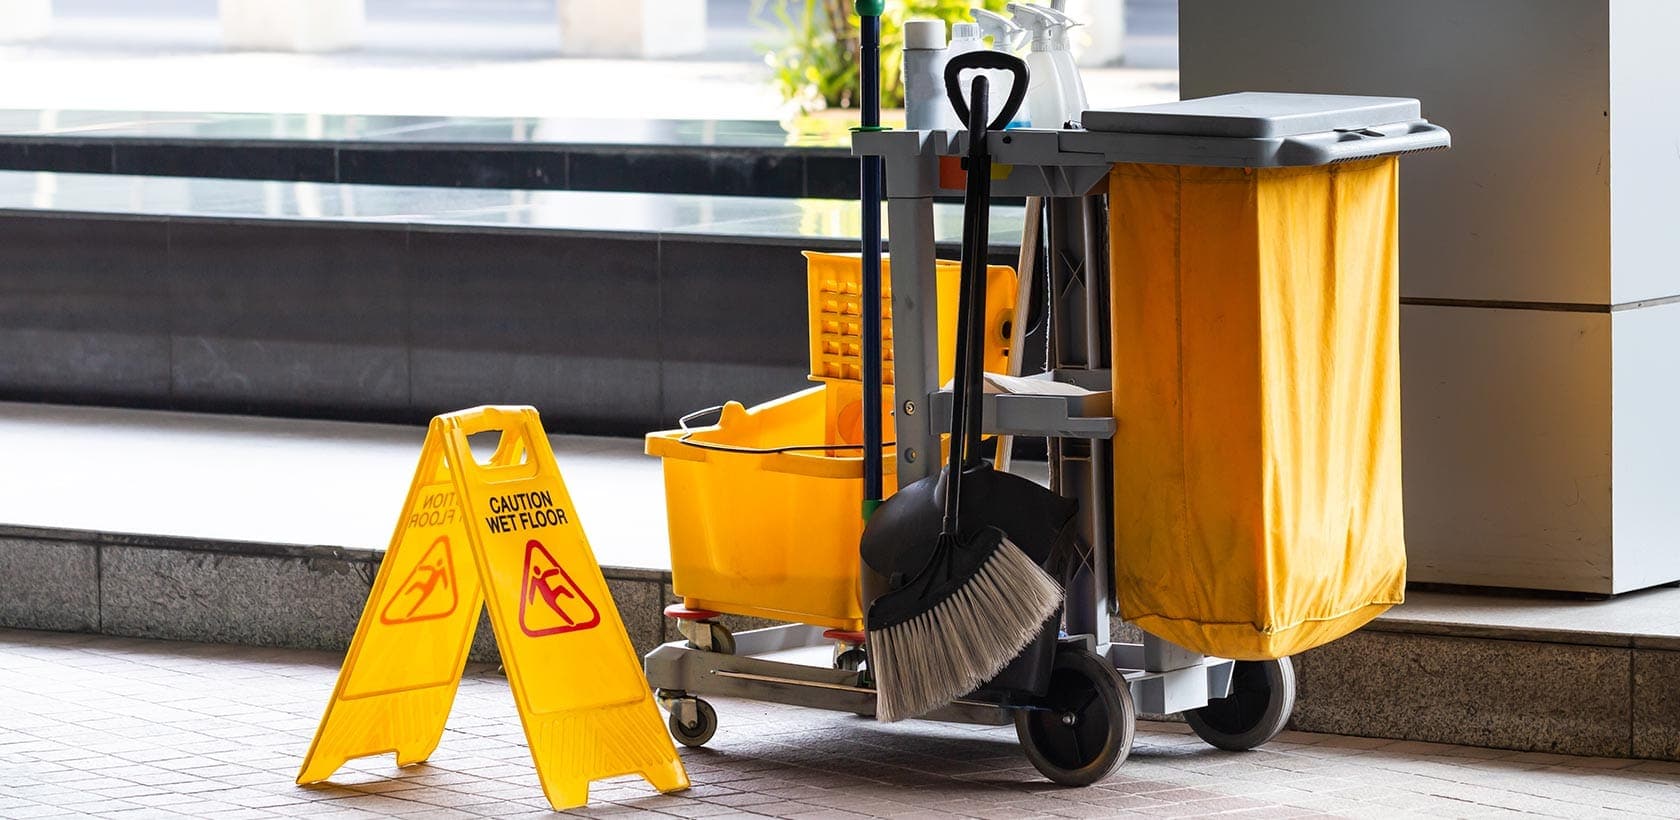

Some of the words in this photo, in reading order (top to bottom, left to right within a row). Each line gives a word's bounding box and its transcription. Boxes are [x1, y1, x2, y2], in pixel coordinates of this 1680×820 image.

[489, 490, 553, 514] CAUTION
[485, 514, 517, 534] WET
[519, 508, 568, 530] FLOOR
